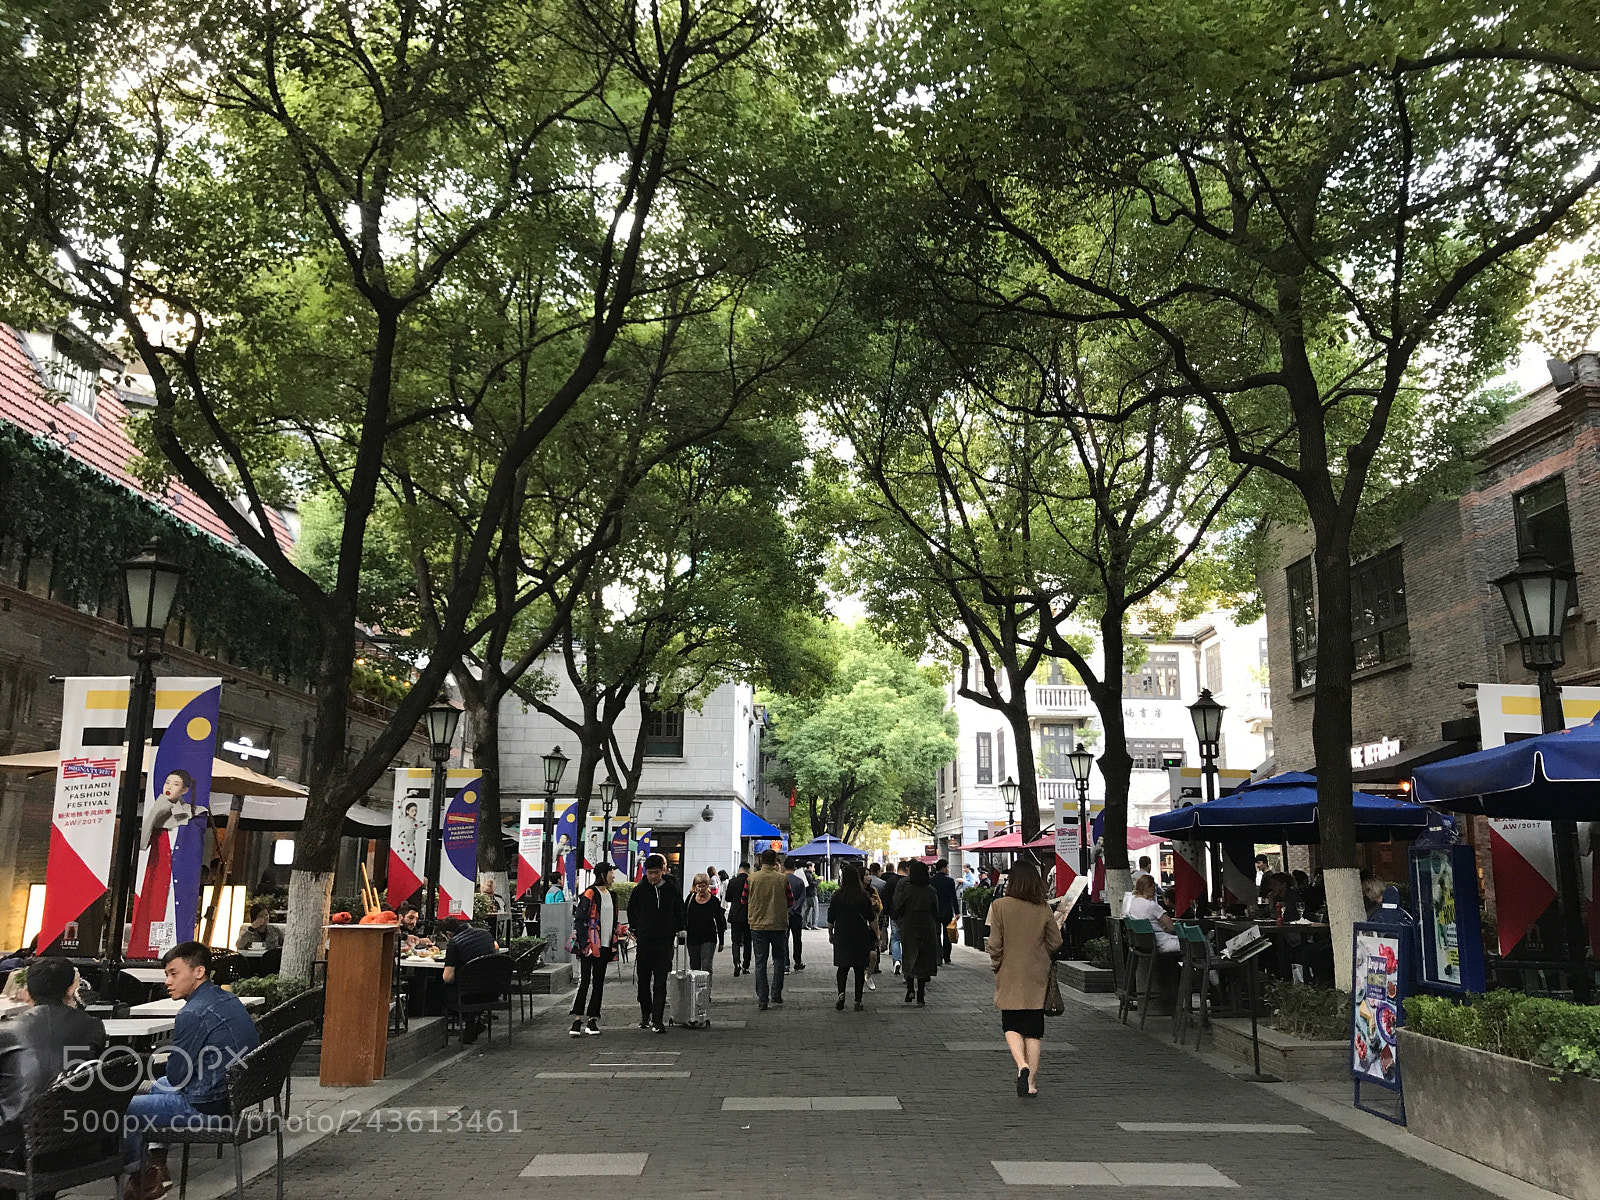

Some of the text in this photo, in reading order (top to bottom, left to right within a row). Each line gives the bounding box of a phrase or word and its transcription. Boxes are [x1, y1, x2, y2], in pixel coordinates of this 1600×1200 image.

[66, 764, 112, 776] SIGNATURE
[64, 782, 111, 792] XINTIANDI
[69, 791, 110, 800] FASHION
[67, 800, 109, 809] FESTIVAL
[64, 818, 102, 826] AW/2017
[1503, 822, 1541, 830] AW/2017
